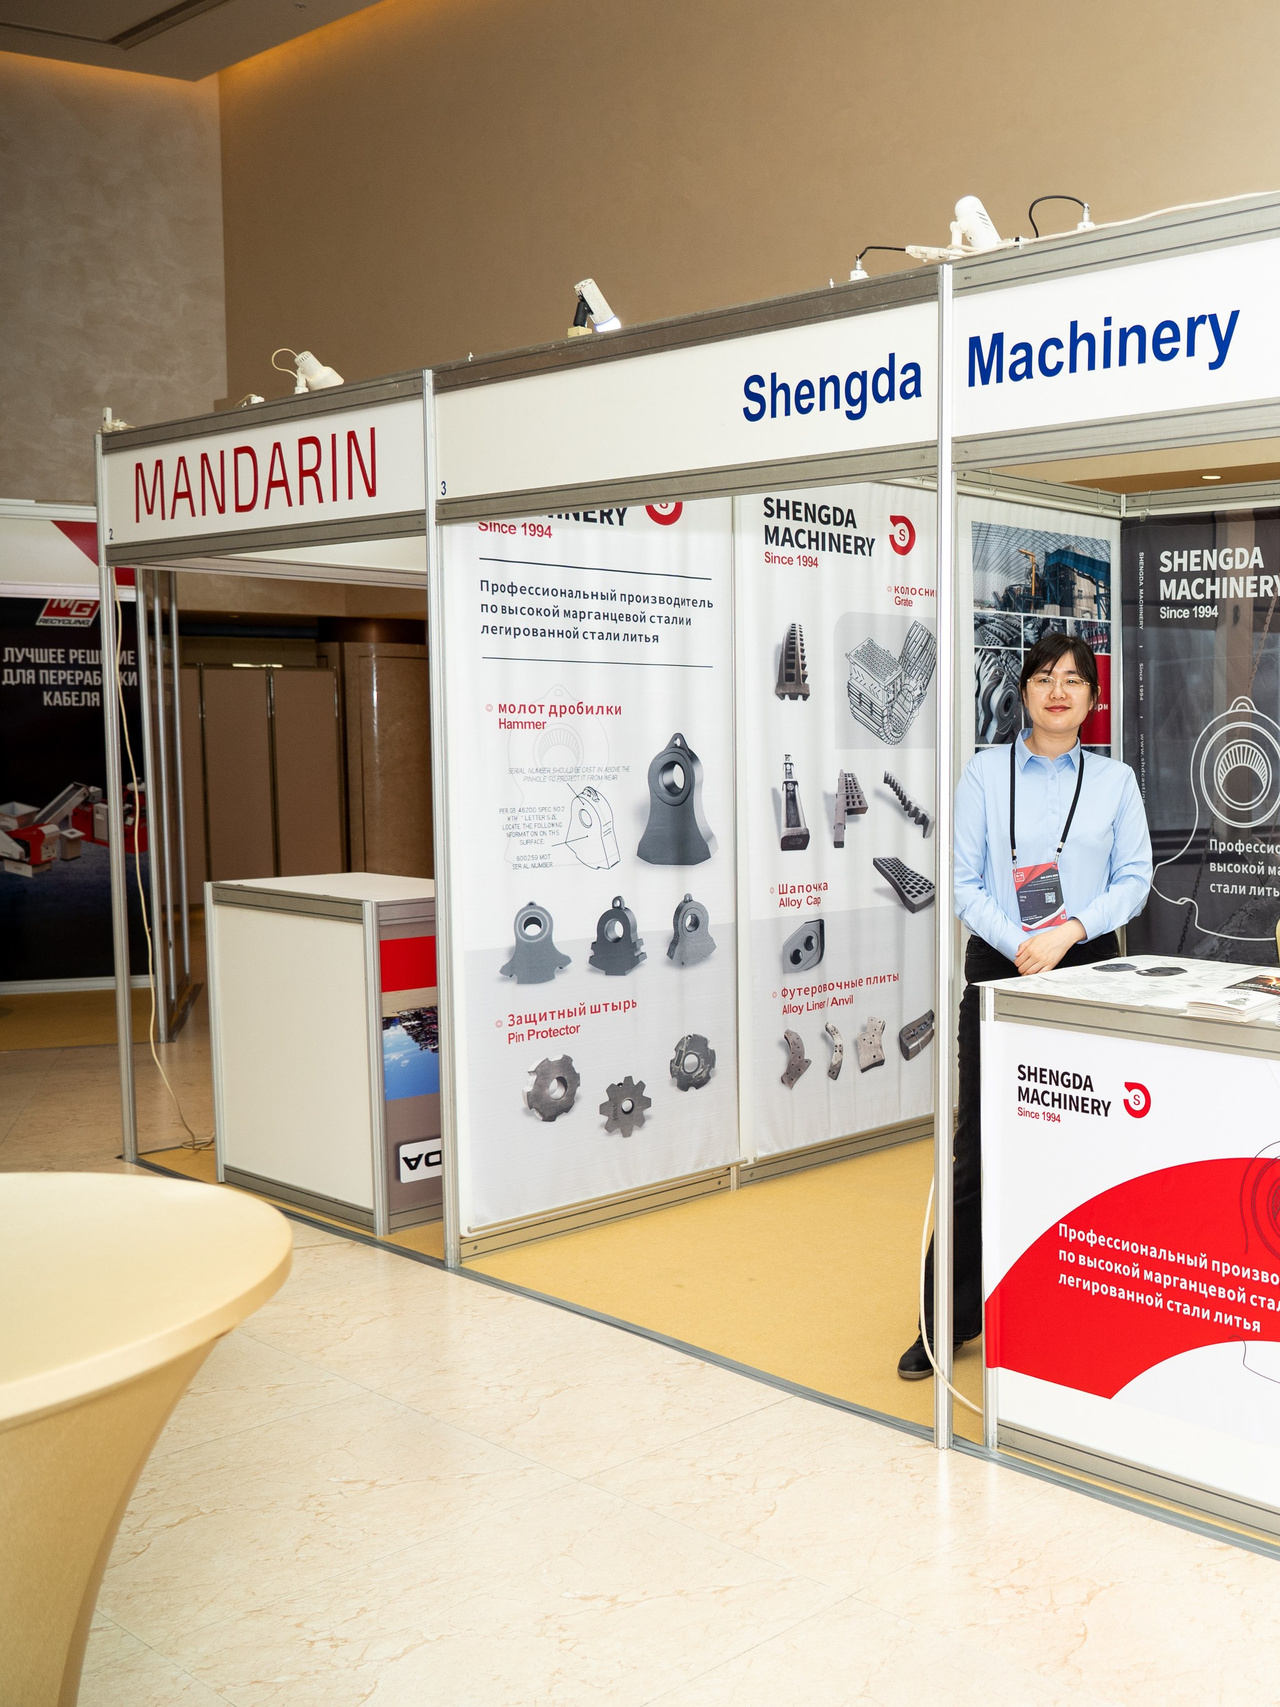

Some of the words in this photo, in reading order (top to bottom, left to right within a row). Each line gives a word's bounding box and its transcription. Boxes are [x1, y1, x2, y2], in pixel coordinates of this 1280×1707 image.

[742, 352, 923, 422] Shengda
[967, 309, 1241, 388] Machinery
[134, 426, 377, 523] MANDARIN
[440, 481, 447, 496] 3
[763, 497, 857, 529] SHENGDA
[108, 528, 114, 540] 2
[478, 521, 517, 535] Since
[522, 522, 553, 538] 1994
[764, 524, 876, 557] MACHINERY
[764, 551, 794, 566] Since
[797, 555, 819, 568] 1994
[1159, 546, 1264, 573] SHENGDA
[480, 580, 617, 602] Профессиональный
[620, 592, 714, 610] производитель
[894, 585, 937, 597] колосни
[894, 595, 913, 607] Grate
[480, 603, 498, 614] по
[501, 604, 560, 618] высокой
[563, 607, 647, 624] марганцевой
[1159, 606, 1190, 619] Since
[1192, 605, 1219, 618] 1994
[38, 618, 91, 626] RECYCLING
[480, 624, 580, 640] легированной
[582, 629, 620, 642] стали
[622, 632, 660, 644] литья
[2, 647, 66, 664] ЛУЧШЕЕ
[69, 649, 136, 666] РЕШИЕ
[1, 669, 35, 686] ДЛЯ
[39, 669, 138, 687] ПЕРЕРАБКИ
[43, 691, 100, 707] КАБЕЛЯ
[498, 703, 545, 714] молот
[548, 701, 622, 717] дробилки
[498, 718, 547, 730] Hammer
[1209, 861, 1265, 875] высокой
[778, 880, 829, 895] Шапочка
[1209, 883, 1246, 895] стали
[778, 896, 803, 909] Alloy
[806, 895, 821, 908] Cap
[781, 978, 864, 1000] Футеровочные
[866, 972, 900, 986] плиты
[507, 1003, 587, 1027] Защитный
[590, 998, 637, 1016] штырь
[782, 1004, 804, 1016] Alloy
[830, 994, 854, 1007] Anvil
[507, 1030, 525, 1044] Pin
[527, 1023, 581, 1040] Protector
[1017, 1063, 1094, 1093] SHENGDA
[1017, 1085, 1112, 1118] MACHINERY
[1017, 1106, 1040, 1120] Since
[1041, 1110, 1061, 1124] 1994
[1058, 1222, 1208, 1270] Профессиональный
[1058, 1249, 1076, 1265] по
[1078, 1255, 1140, 1279] высокой
[1143, 1270, 1247, 1305] марганцевой
[1058, 1271, 1164, 1309] легированной
[1166, 1299, 1211, 1321] стали
[1213, 1310, 1262, 1333] литья
